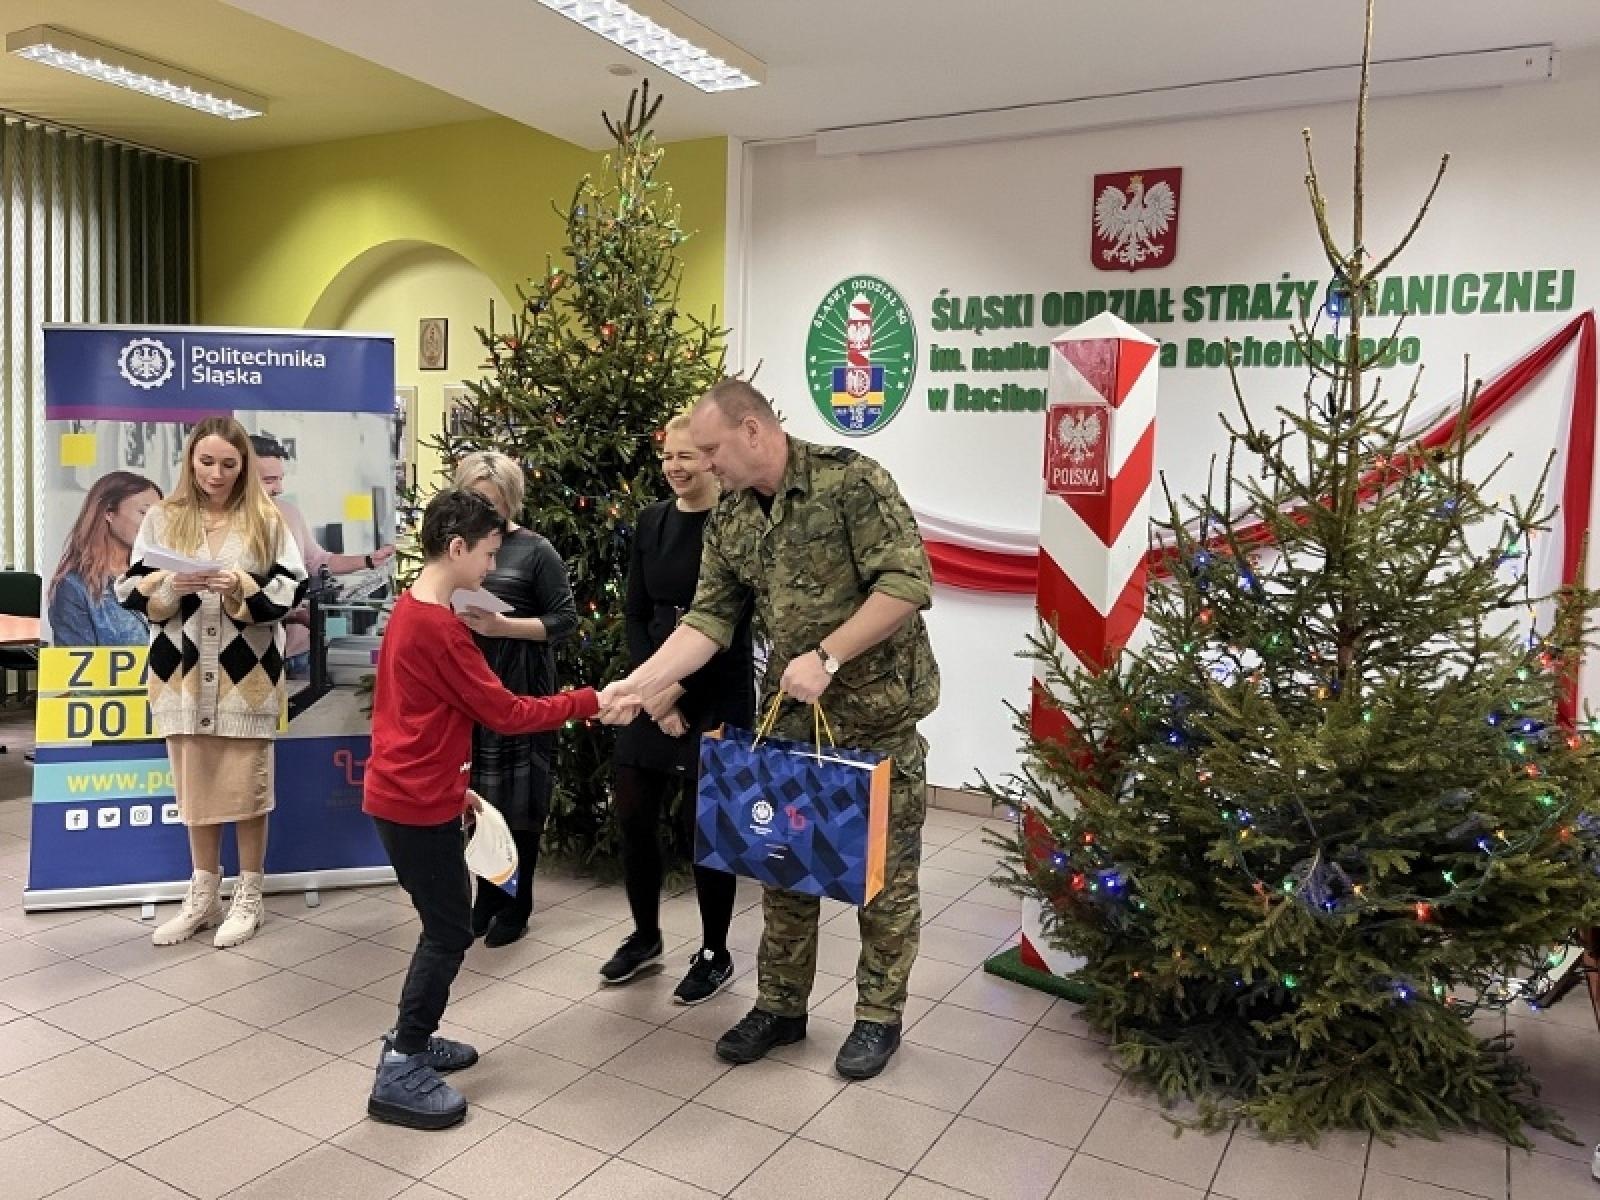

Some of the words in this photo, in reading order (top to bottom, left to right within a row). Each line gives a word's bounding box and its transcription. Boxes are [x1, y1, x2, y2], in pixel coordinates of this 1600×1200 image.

[931, 288, 1034, 335] ŚLĄSKI
[1041, 286, 1174, 328] ODDZIAŁ
[1183, 271, 1319, 322] STRAŻY
[191, 345, 327, 369] Politechnika
[929, 343, 967, 372] im.
[972, 341, 1049, 372] nadko
[191, 362, 263, 387] Śląska
[927, 388, 949, 411] w
[1053, 467, 1099, 486] POLSKA
[67, 651, 94, 687] Z
[67, 700, 127, 739] DO
[66, 769, 177, 794] www.po
